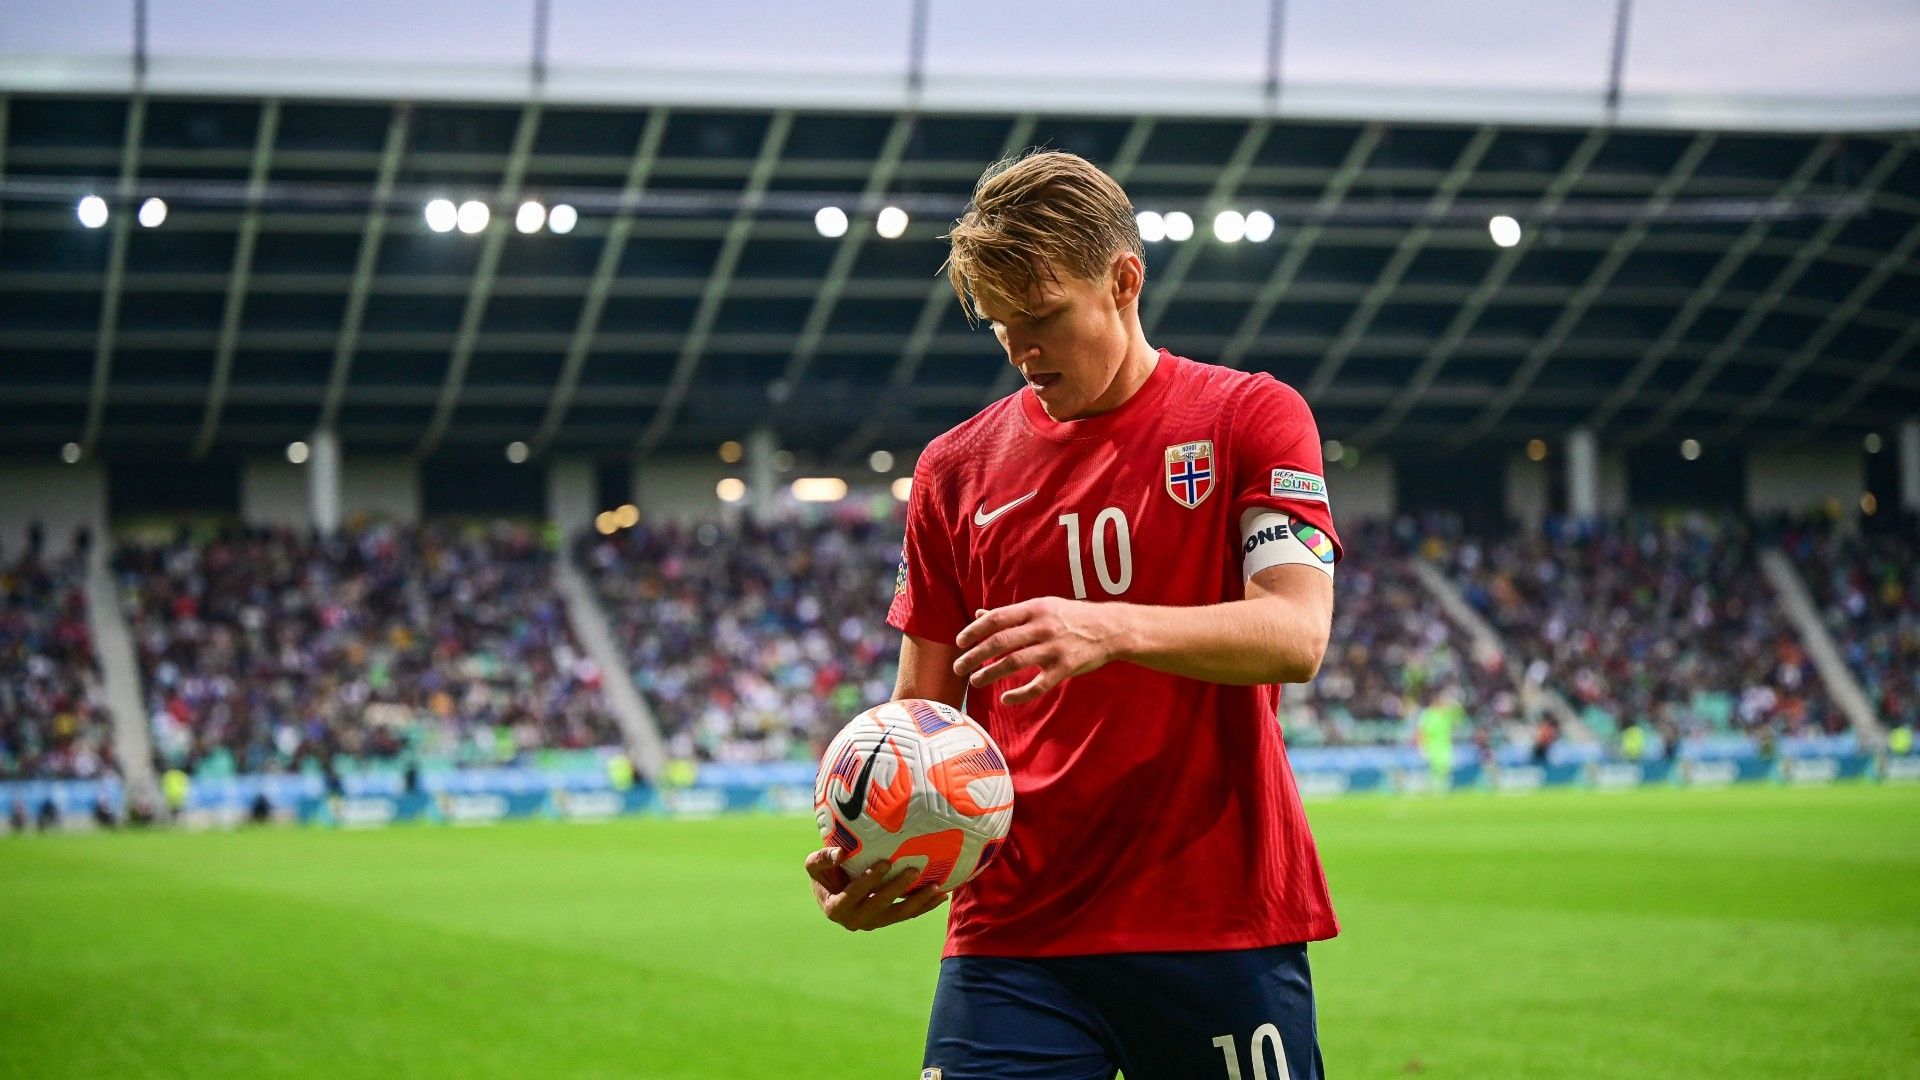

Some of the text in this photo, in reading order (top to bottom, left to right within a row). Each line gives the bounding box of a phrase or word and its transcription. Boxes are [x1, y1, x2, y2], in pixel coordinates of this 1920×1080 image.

[1274, 470, 1294, 478] UEFA
[1059, 507, 1132, 599] 10
[1244, 525, 1288, 553] ONE
